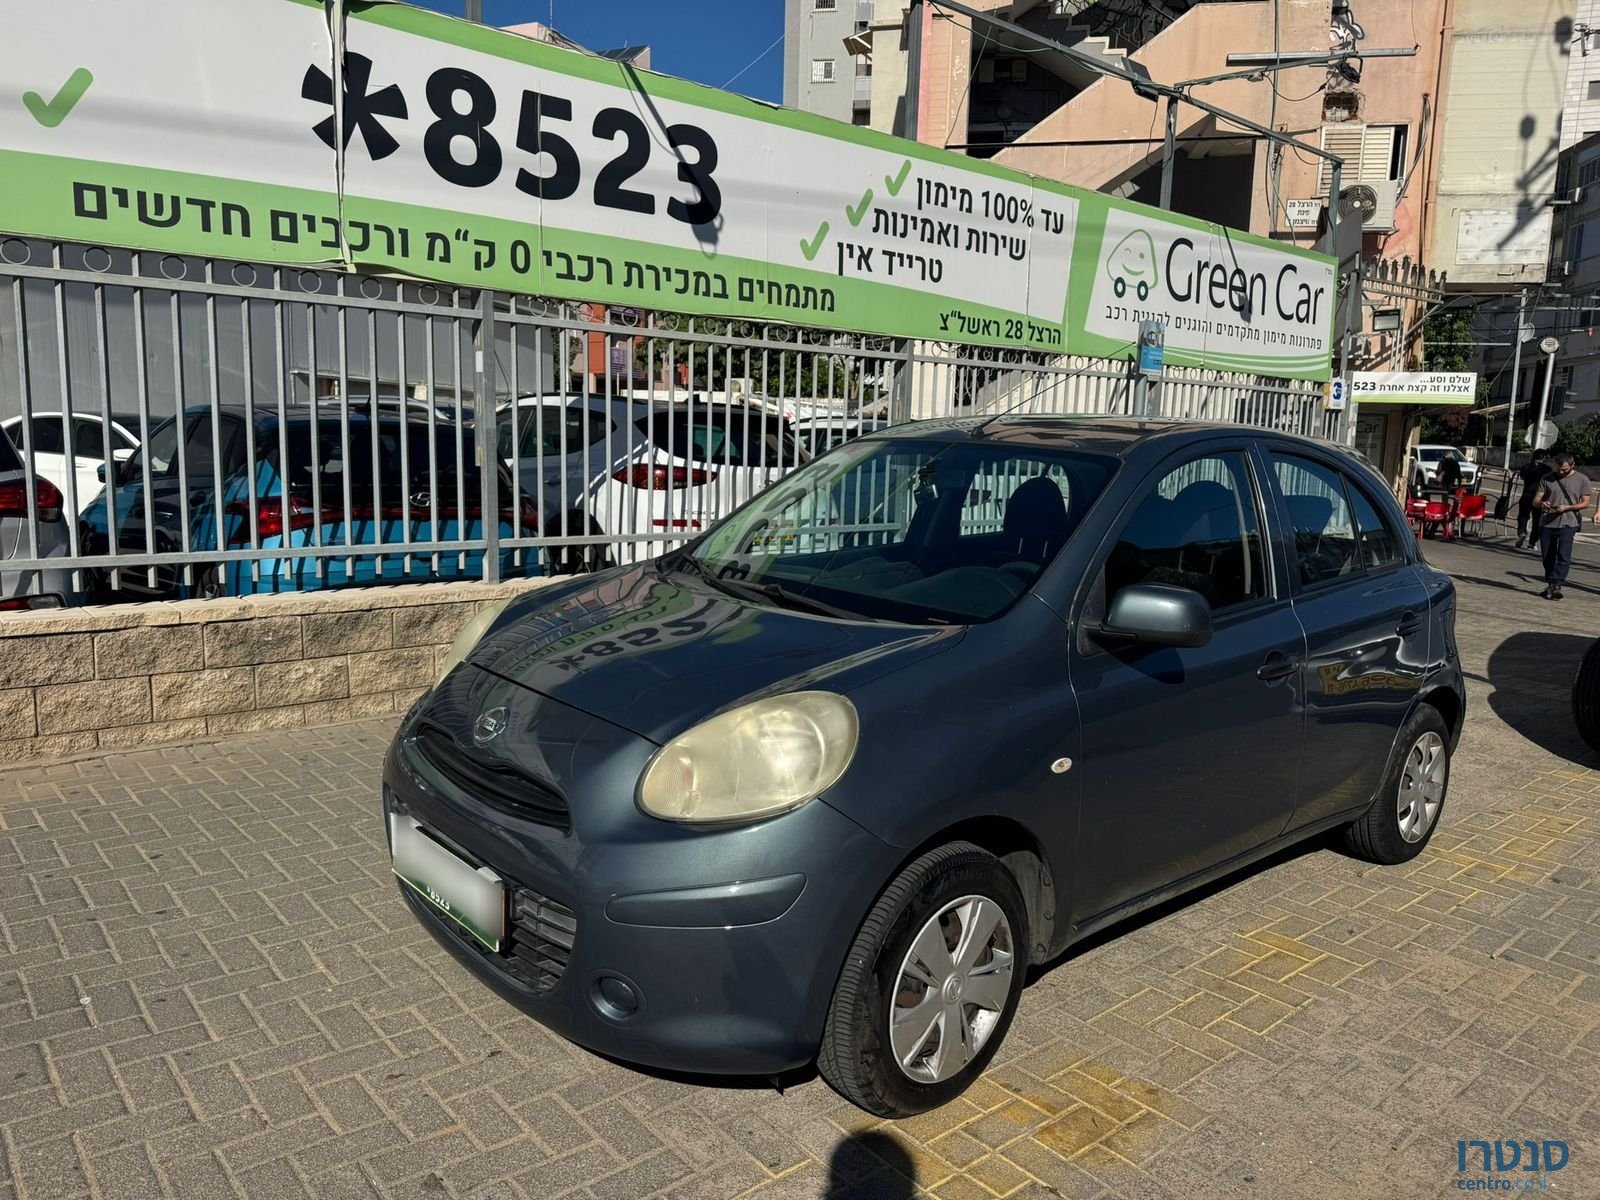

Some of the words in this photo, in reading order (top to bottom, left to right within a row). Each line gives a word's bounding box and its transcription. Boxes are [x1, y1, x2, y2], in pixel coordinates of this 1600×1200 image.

[73, 181, 251, 238] חדשים
[917, 177, 973, 214] מימון
[981, 190, 1034, 228] 100%
[270, 209, 409, 258] ורכבים
[872, 207, 959, 249] ואמינות
[1041, 208, 1064, 234] עד
[510, 239, 531, 274] 0
[837, 241, 874, 276] אין
[966, 228, 1026, 261] שירות
[542, 250, 613, 285] רכבי
[623, 261, 729, 299] במכירת
[882, 249, 943, 283] טרייד
[738, 277, 835, 312] מתמחים
[1165, 237, 1267, 316] Green
[1275, 263, 1325, 326] Car
[1105, 304, 1127, 321] רכב
[1175, 316, 1212, 334] והוגנים
[1005, 318, 1023, 340] 28
[1027, 321, 1061, 345] הרצל
[1216, 321, 1260, 343] מתקדמים
[1263, 331, 1286, 346] מימון
[1288, 335, 1322, 350] פתרונות
[1379, 384, 1405, 392] אחרת
[1407, 384, 1427, 394] קצת
[1430, 384, 1440, 392] זה
[1443, 384, 1470, 393] אצלנו
[1449, 375, 1471, 384] שלם
